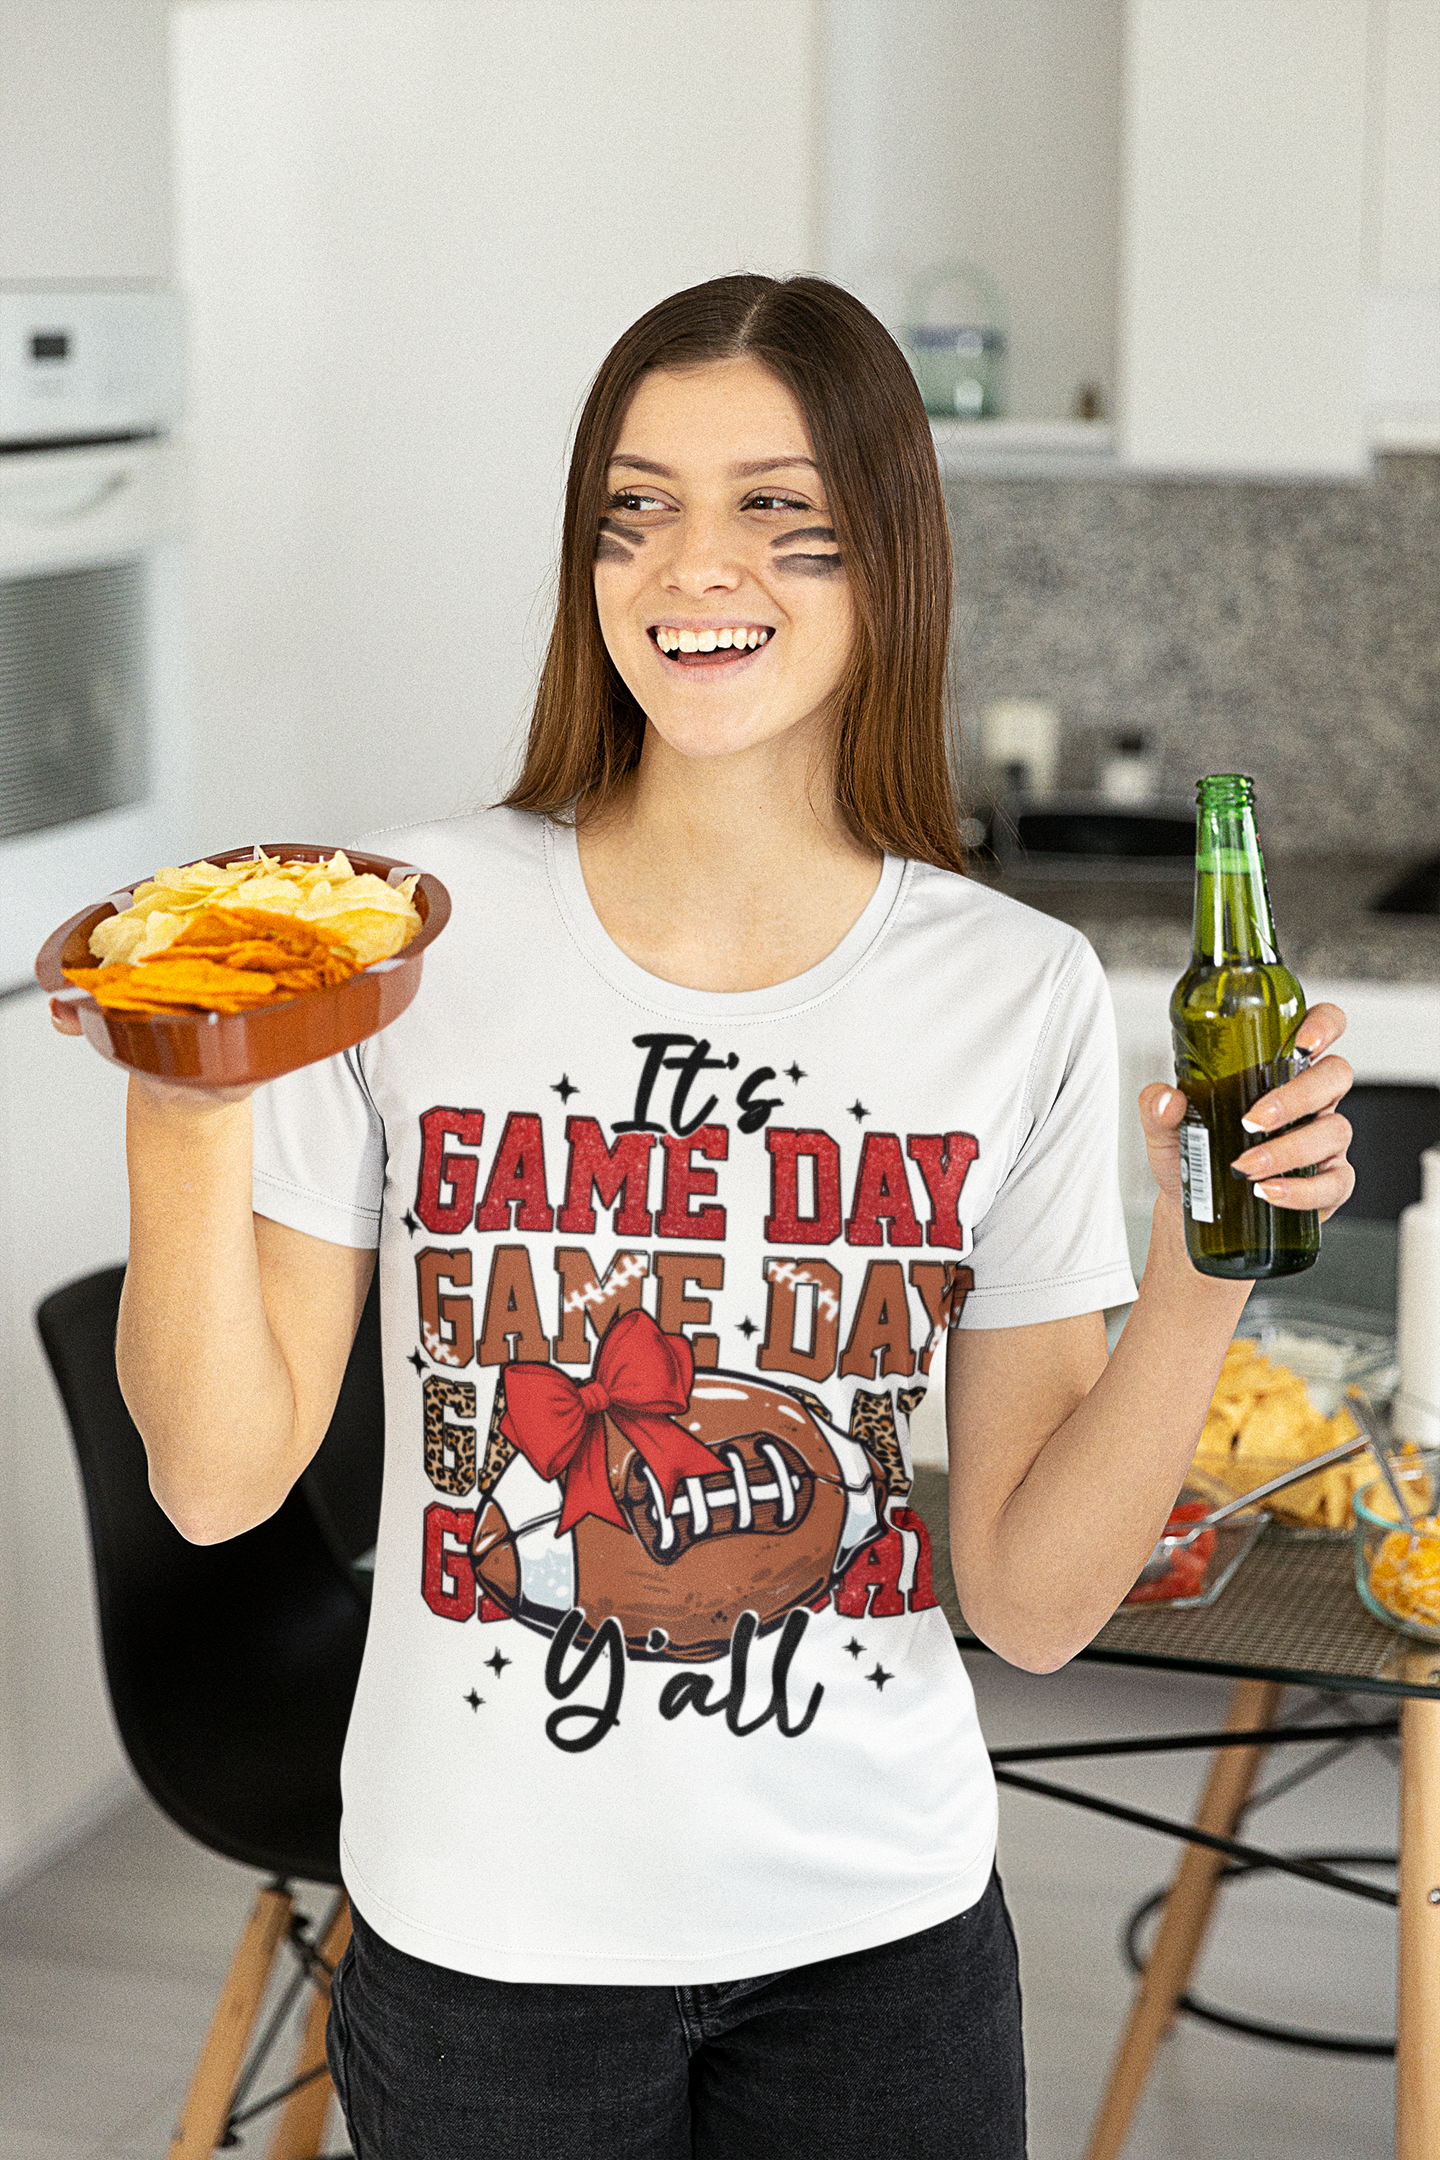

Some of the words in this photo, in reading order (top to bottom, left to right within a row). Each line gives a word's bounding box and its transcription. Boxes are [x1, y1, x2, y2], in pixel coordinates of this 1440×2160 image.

[611, 1033, 785, 1136] It's
[414, 1106, 729, 1241] GAME
[764, 1126, 979, 1250] DAY
